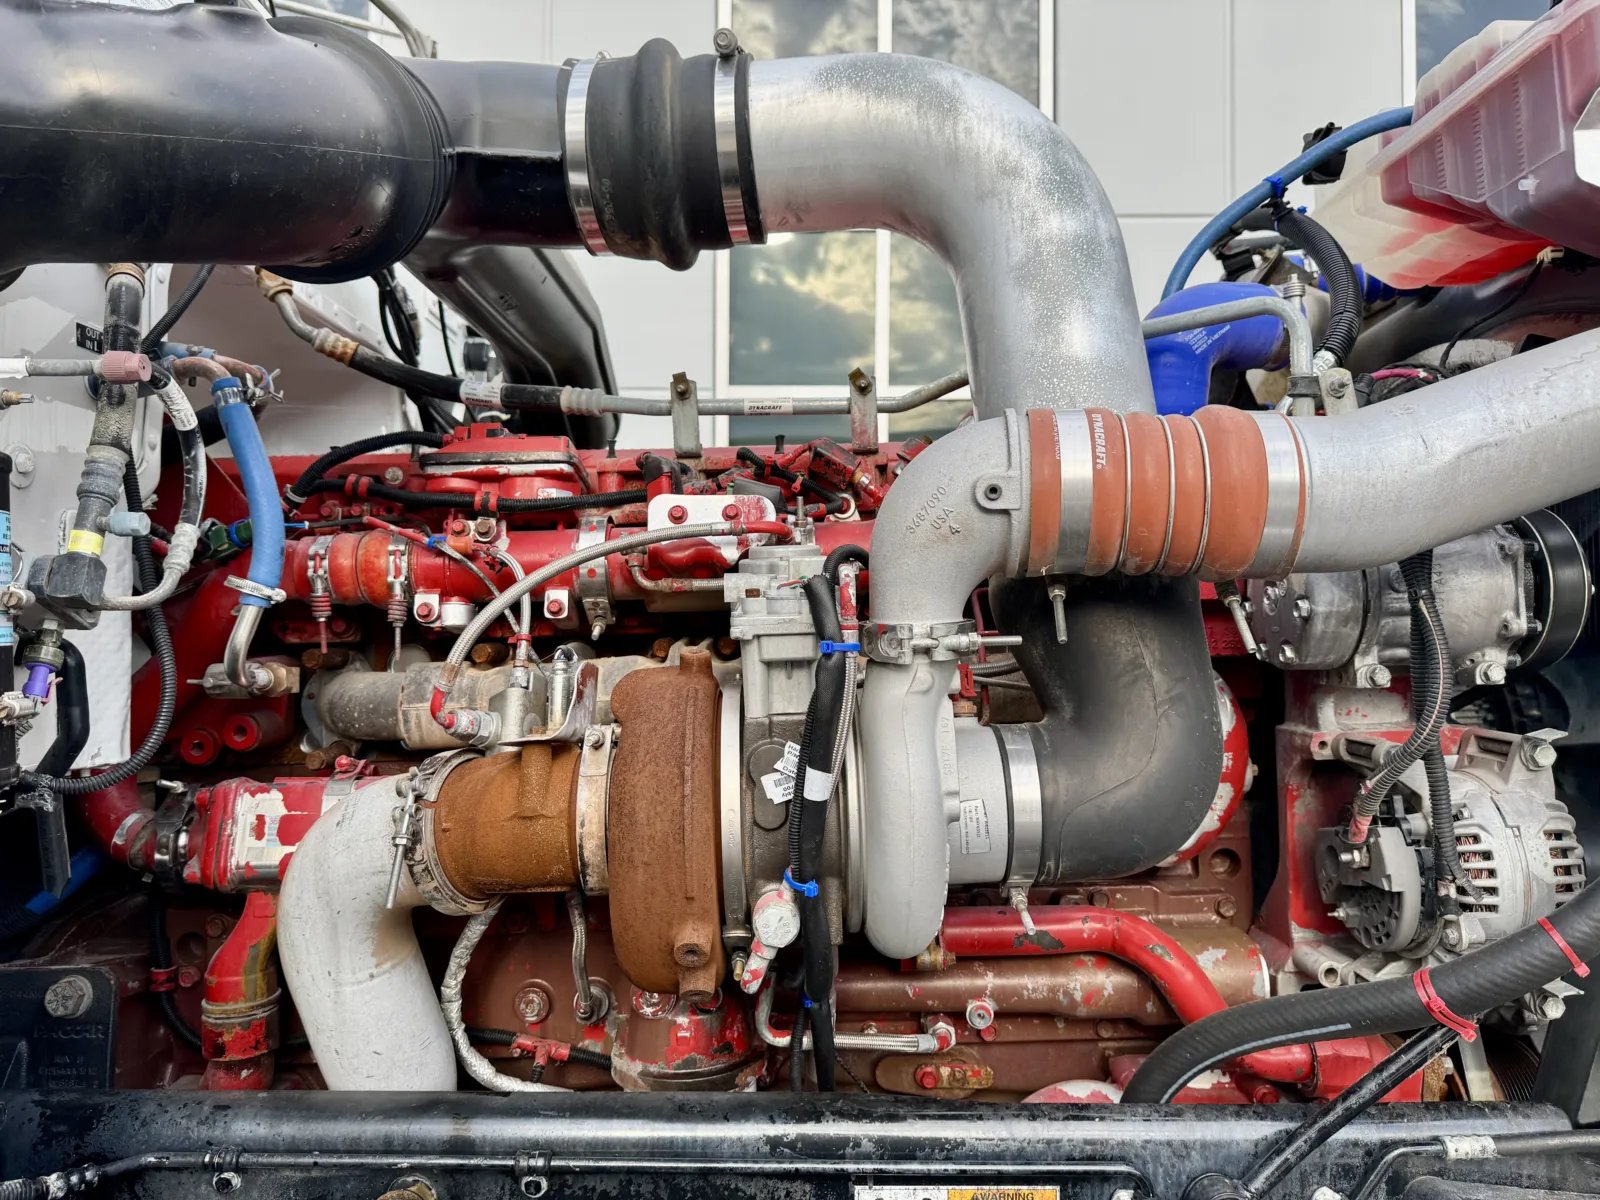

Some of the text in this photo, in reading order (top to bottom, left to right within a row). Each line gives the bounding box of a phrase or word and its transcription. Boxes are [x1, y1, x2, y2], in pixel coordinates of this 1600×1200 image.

[85, 327, 101, 340] OUT
[1211, 323, 1231, 341] VIETNAM
[905, 485, 947, 534] 3687090
[930, 506, 955, 530] USA
[948, 522, 962, 535] 4
[980, 1192, 1034, 1200] WARNING
